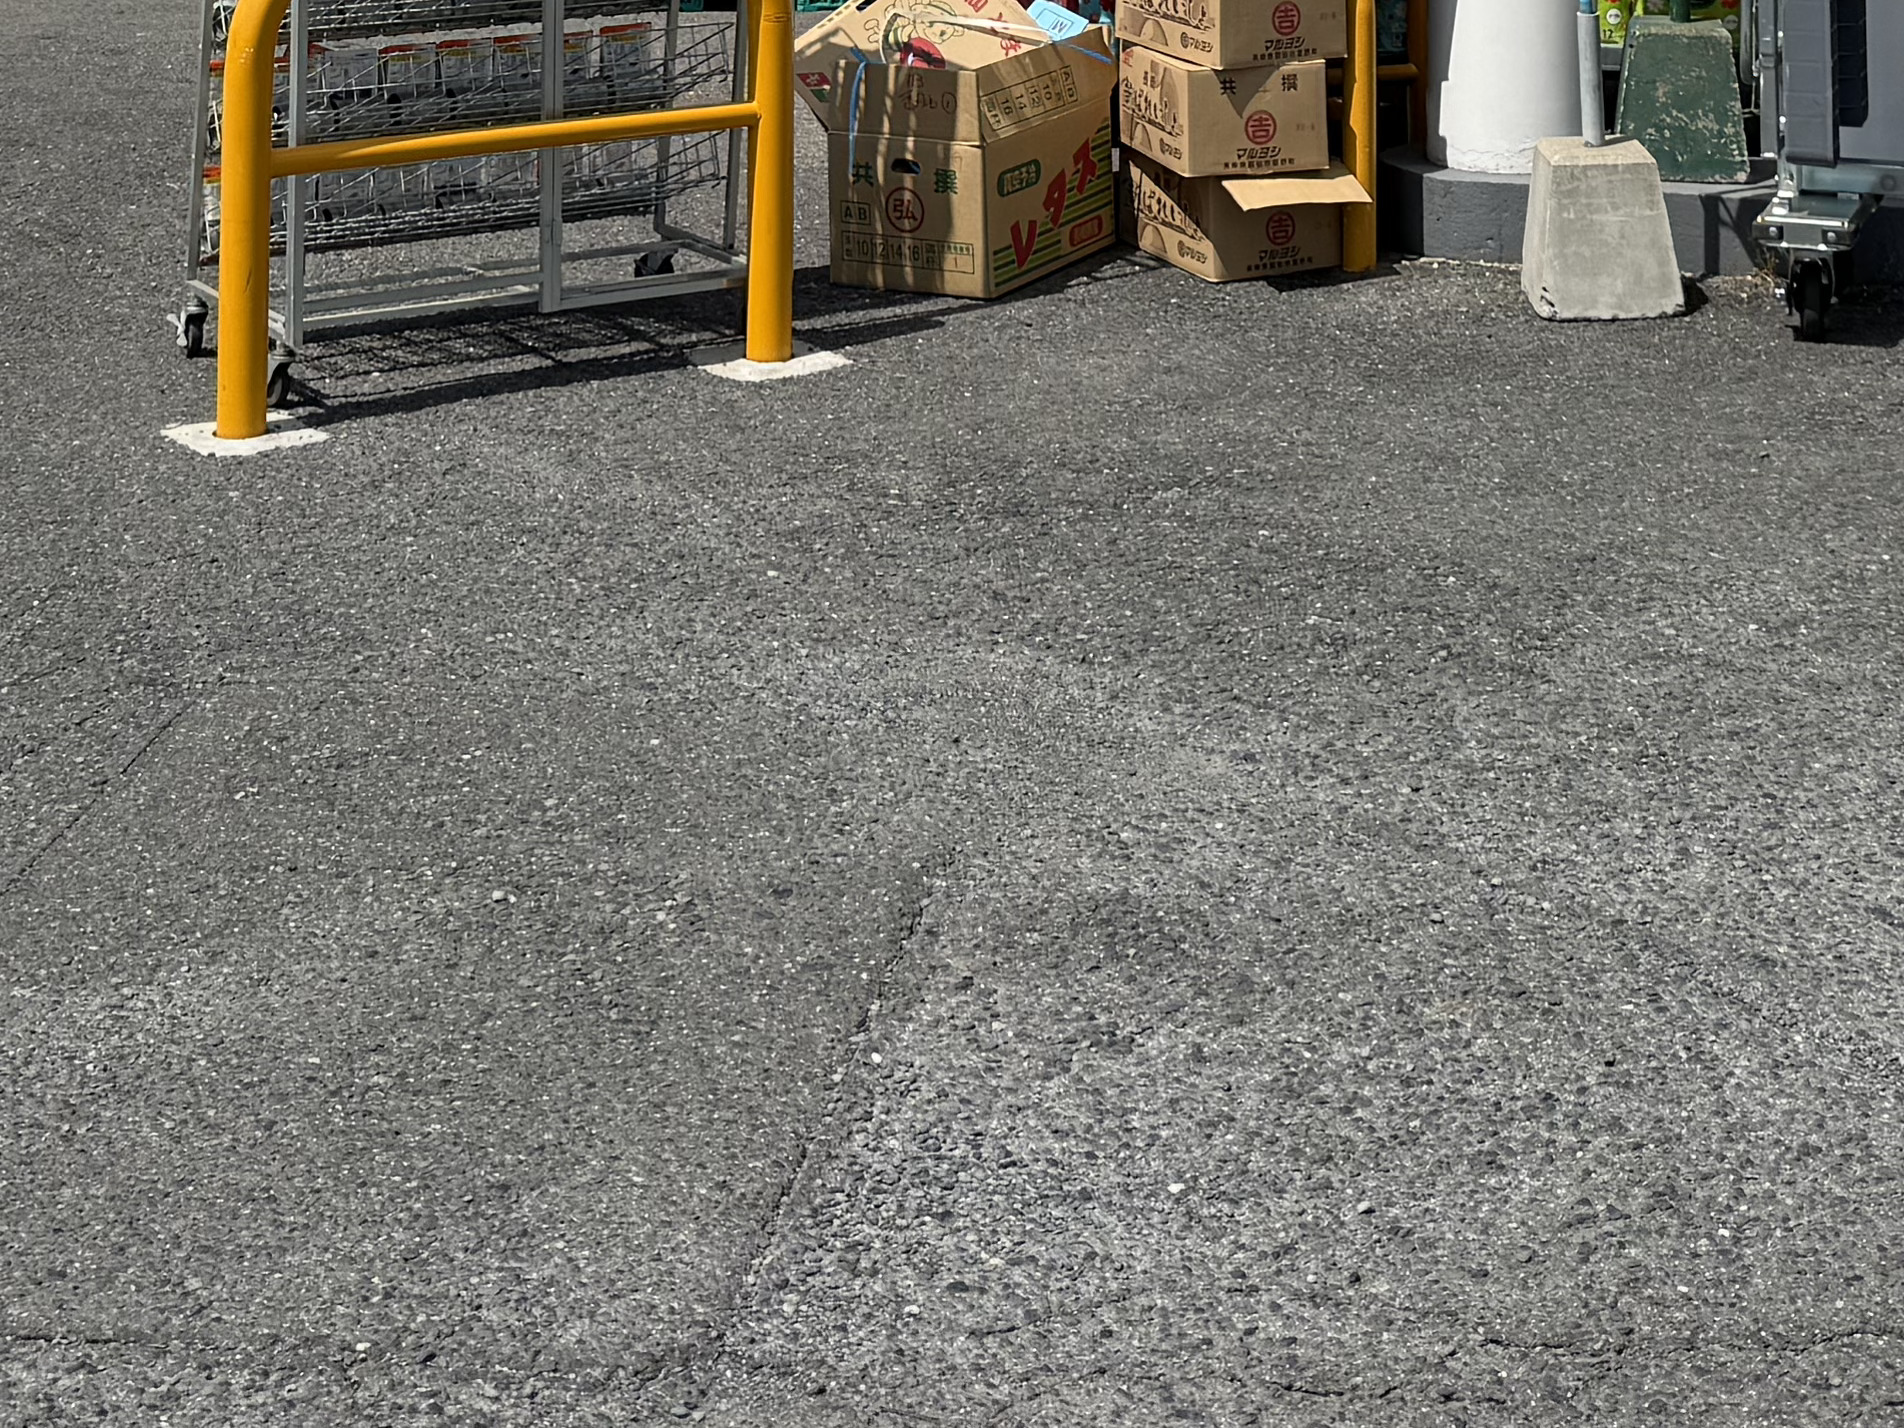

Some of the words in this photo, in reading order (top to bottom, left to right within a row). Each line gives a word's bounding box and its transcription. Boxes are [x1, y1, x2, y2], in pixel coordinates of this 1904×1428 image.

[1275, 3, 1298, 32] 吉
[1189, 35, 1214, 54] マルヨシ
[1264, 36, 1305, 52] マルヨシ
[1219, 77, 1237, 96] 共
[1247, 112, 1275, 142] 吉
[1236, 146, 1282, 160] マルヨシ
[852, 162, 875, 187] 共
[1009, 137, 1099, 270] レタス
[1268, 213, 1293, 242] 吉
[1257, 246, 1301, 263] マルヨシ
